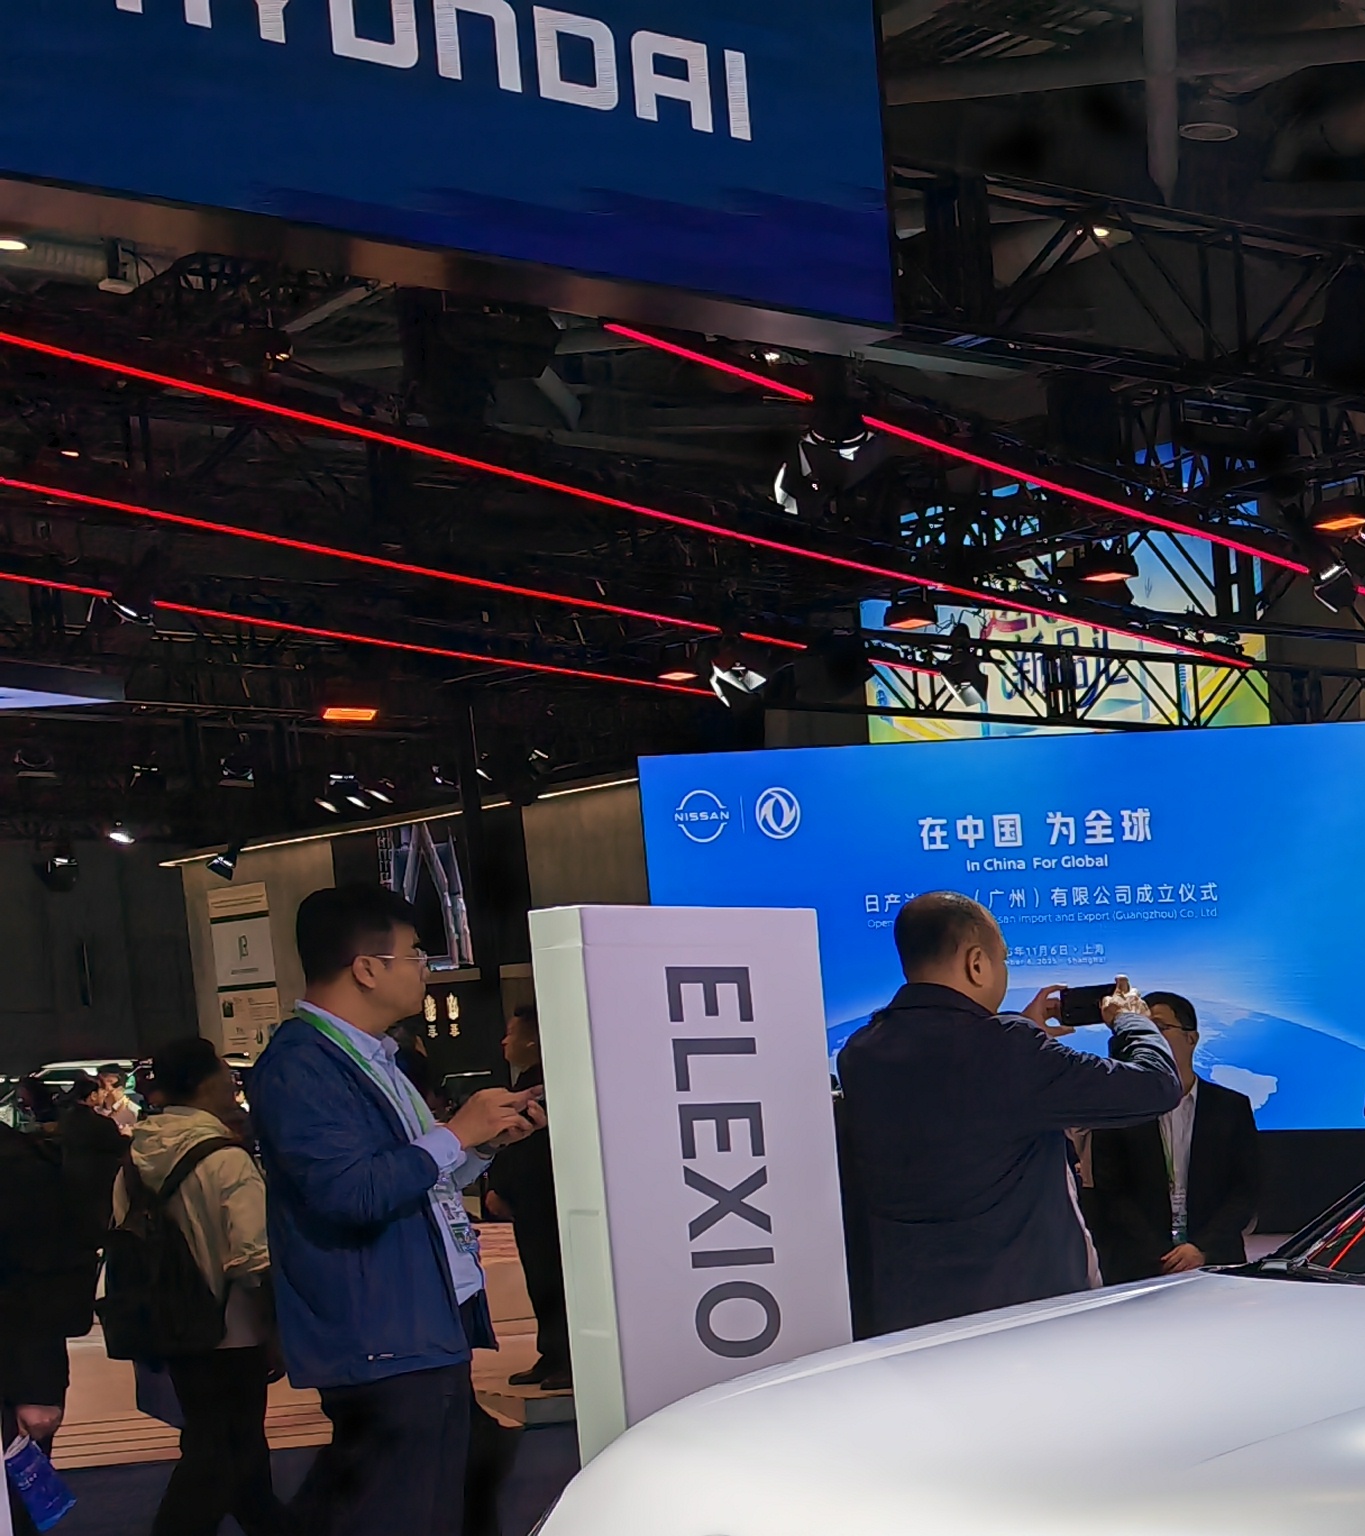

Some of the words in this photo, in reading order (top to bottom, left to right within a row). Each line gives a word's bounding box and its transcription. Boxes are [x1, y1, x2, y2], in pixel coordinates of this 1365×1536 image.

[674, 809, 730, 823] NISSAN
[918, 813, 1024, 851] 在中国
[1046, 808, 1152, 846] 为全球
[966, 857, 981, 872] In
[983, 856, 1026, 871] China
[1033, 855, 1058, 870] For
[1061, 854, 1108, 870] Global
[867, 919, 895, 929] Open
[1078, 912, 1110, 923] Export
[665, 966, 781, 1358] ELEXIO
